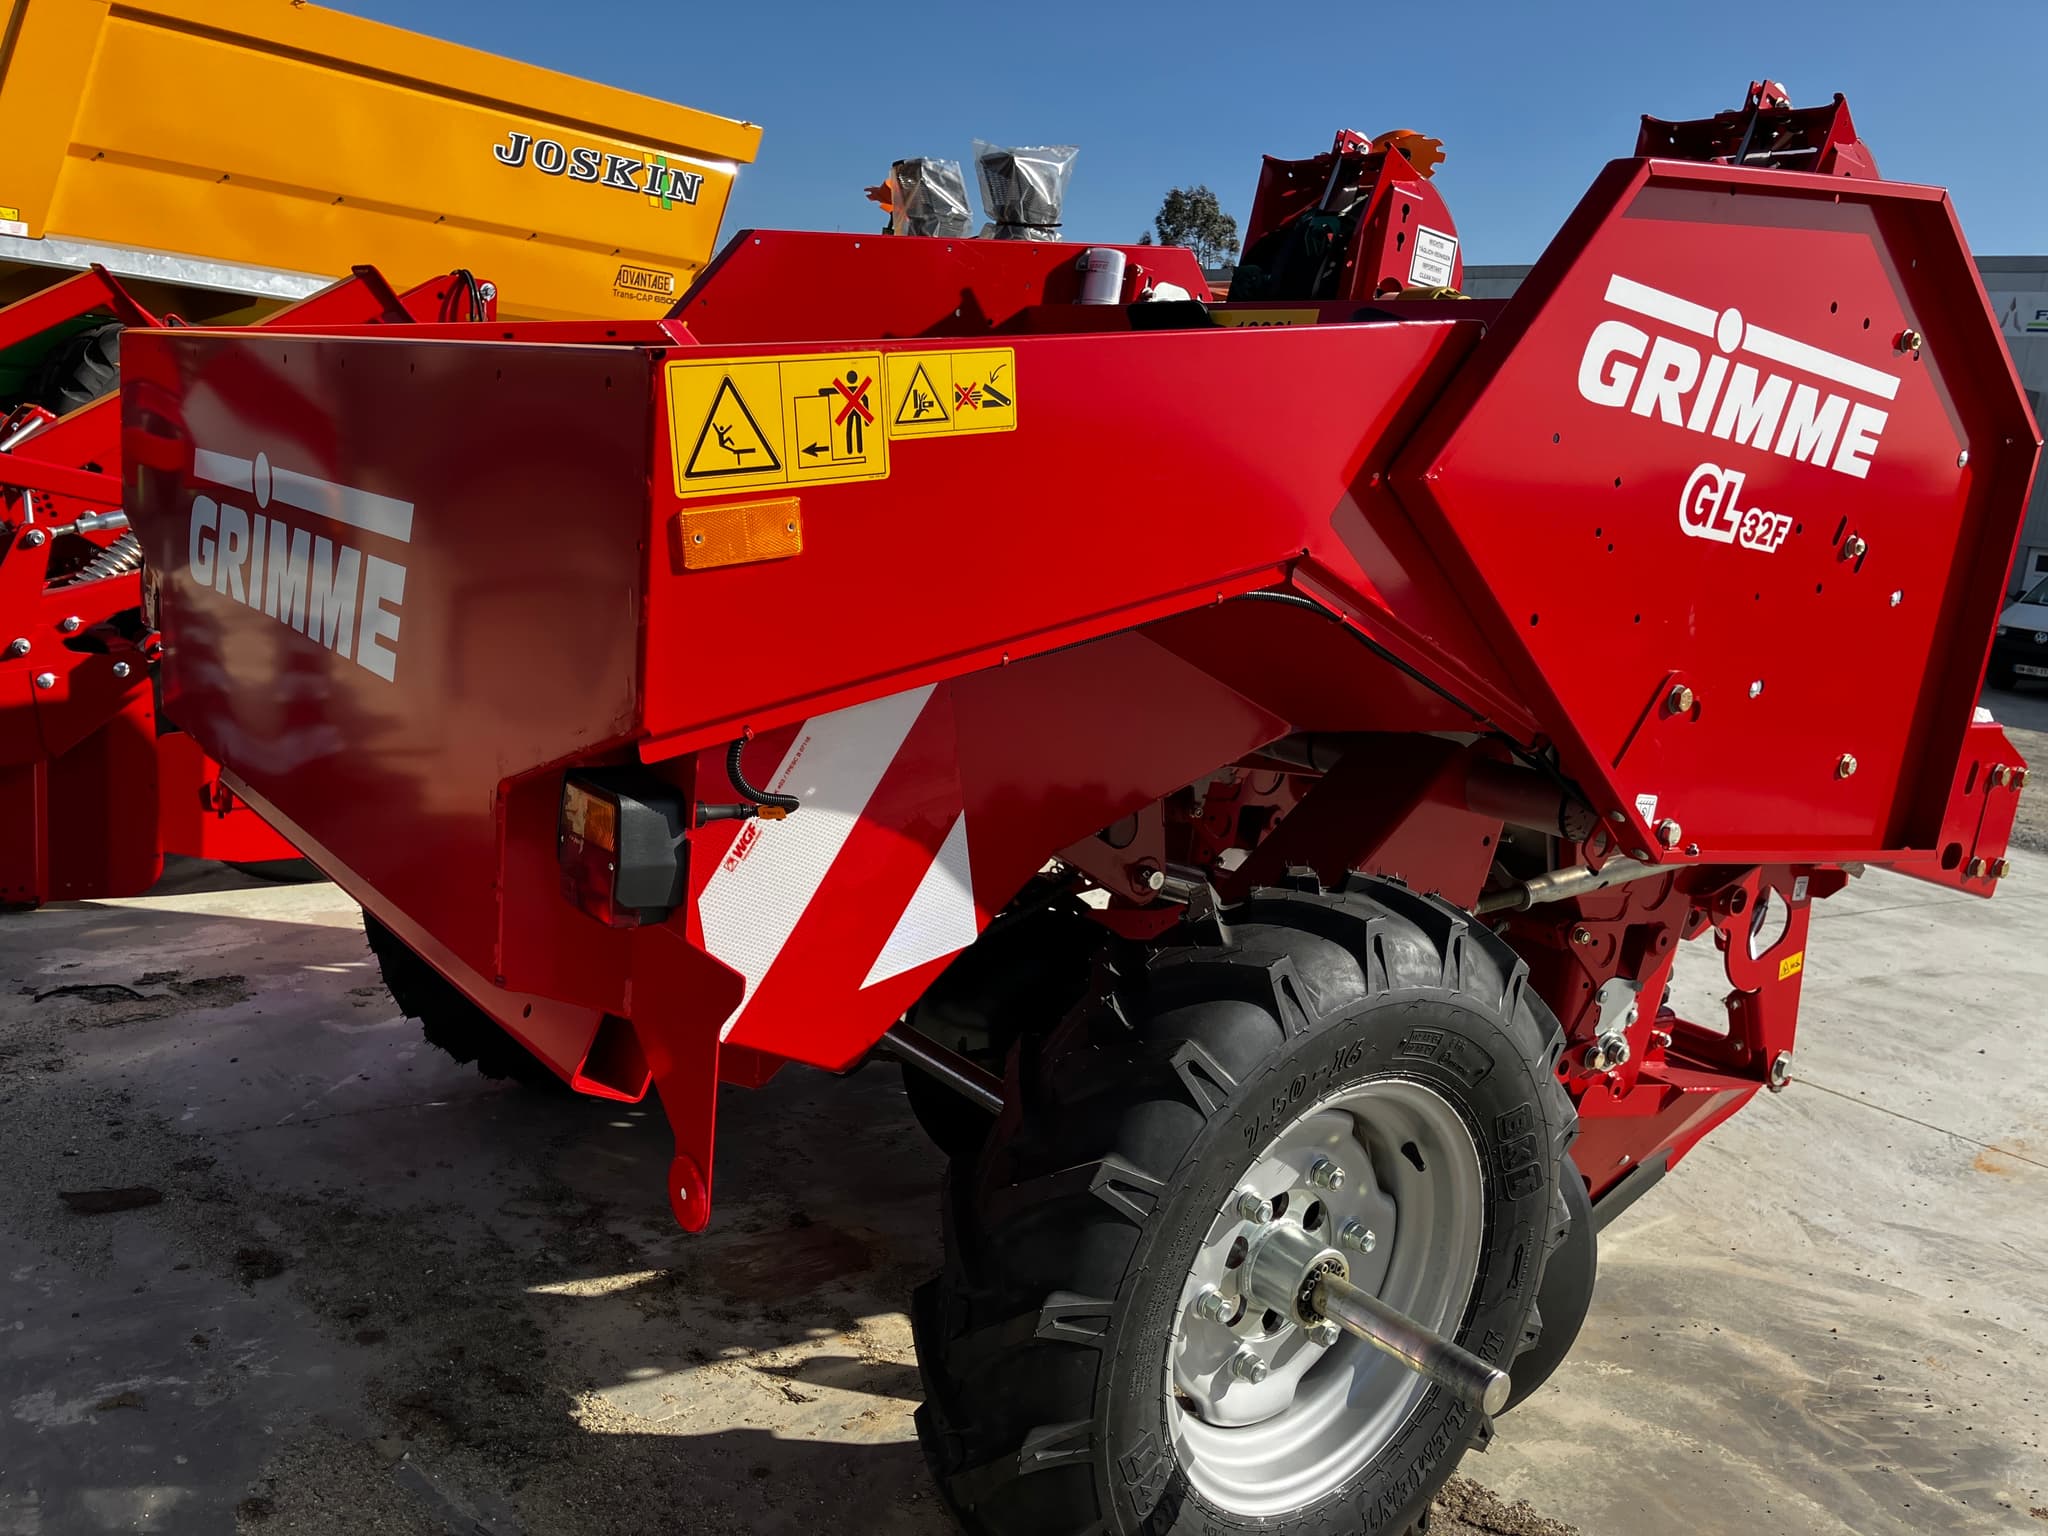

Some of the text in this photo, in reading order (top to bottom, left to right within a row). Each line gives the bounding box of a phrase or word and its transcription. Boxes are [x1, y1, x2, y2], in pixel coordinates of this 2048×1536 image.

[493, 132, 703, 204] JOSKIN
[612, 288, 654, 303] Trans-CAP
[613, 268, 670, 291] ADVANTAGE
[1578, 308, 1888, 479] GRIMME
[1679, 463, 1793, 553] GL 32F
[189, 452, 406, 683] GRIMME
[732, 822, 757, 859] WGF
[1496, 1102, 1543, 1200] BKT
